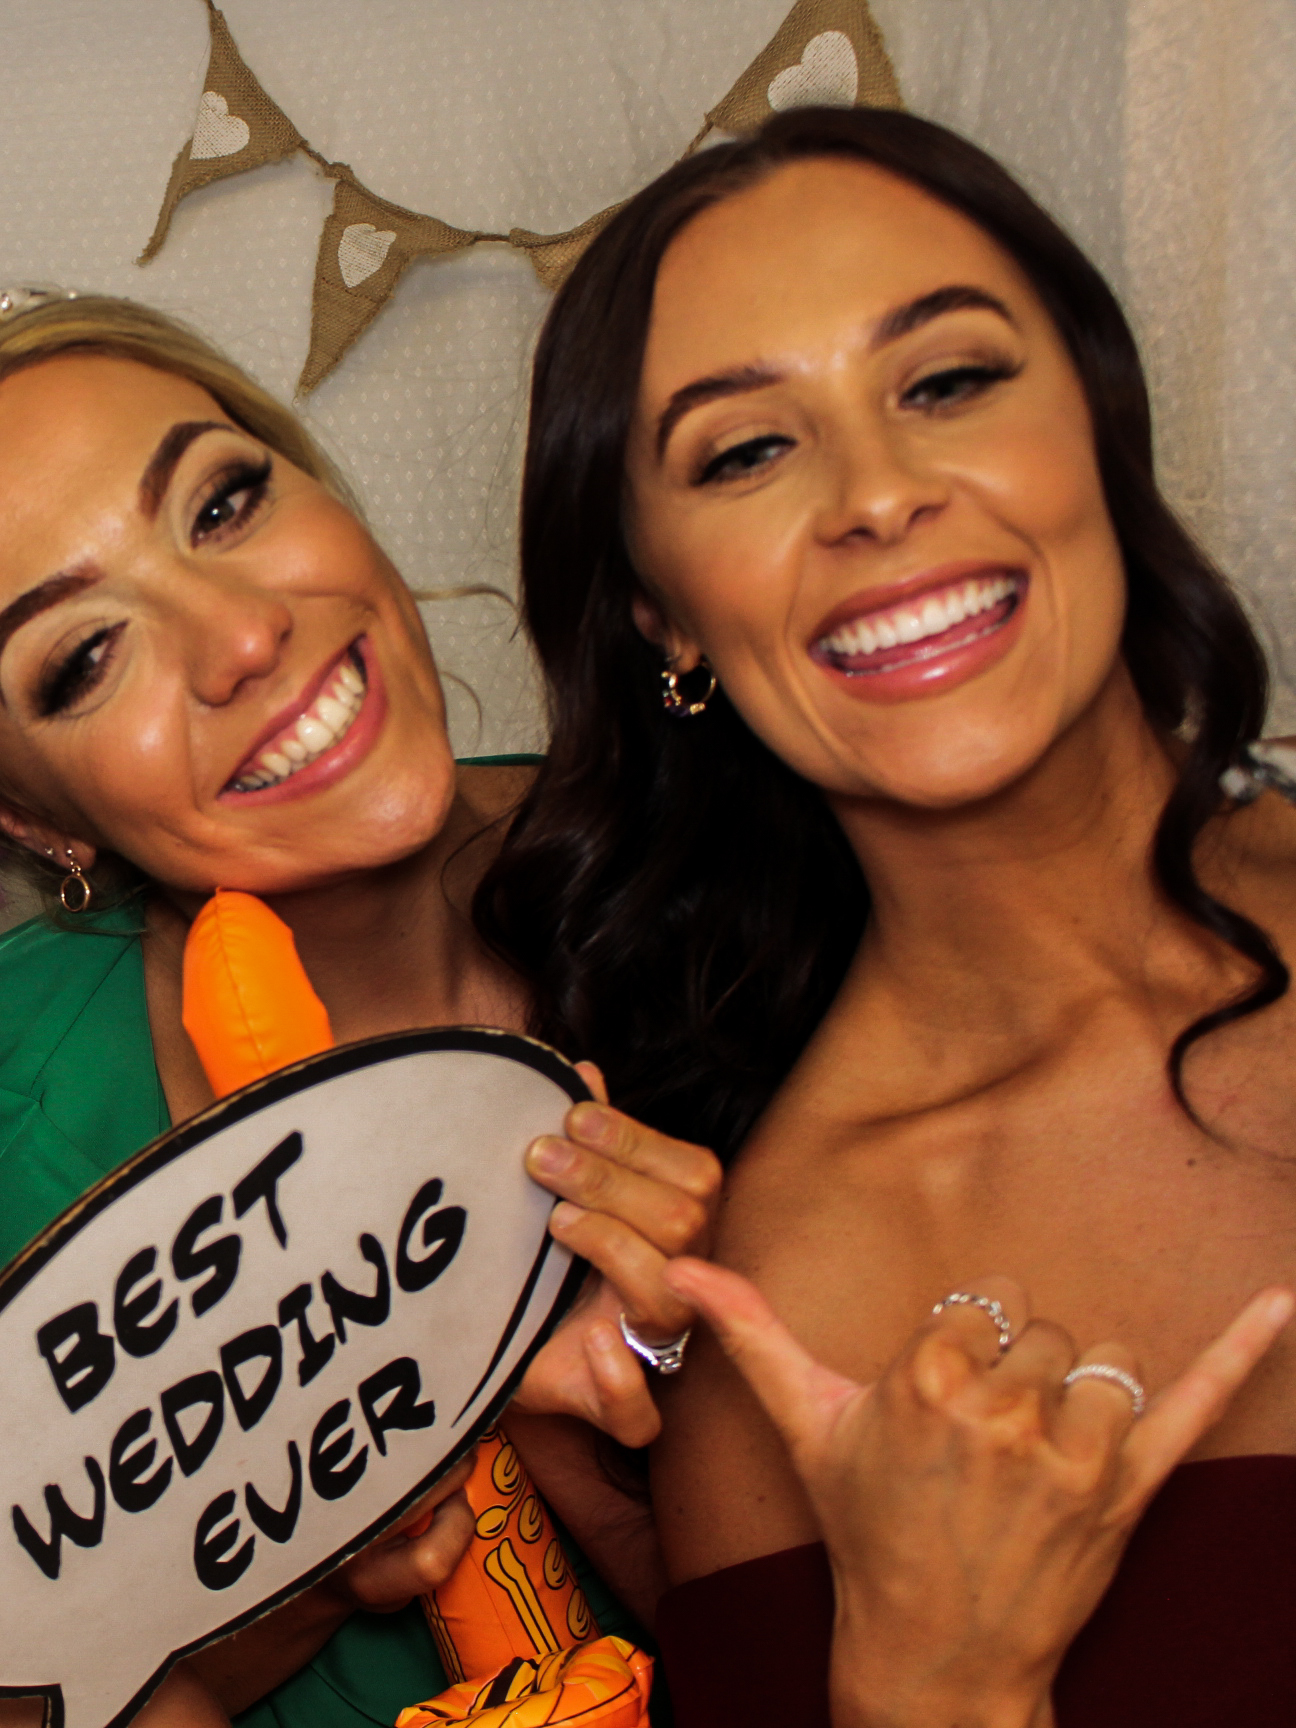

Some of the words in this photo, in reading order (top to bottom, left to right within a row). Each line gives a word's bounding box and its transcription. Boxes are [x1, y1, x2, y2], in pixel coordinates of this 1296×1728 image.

[11, 1177, 467, 1580] WEDDING
[36, 1129, 304, 1413] BEST
[194, 1356, 436, 1591] EVER
